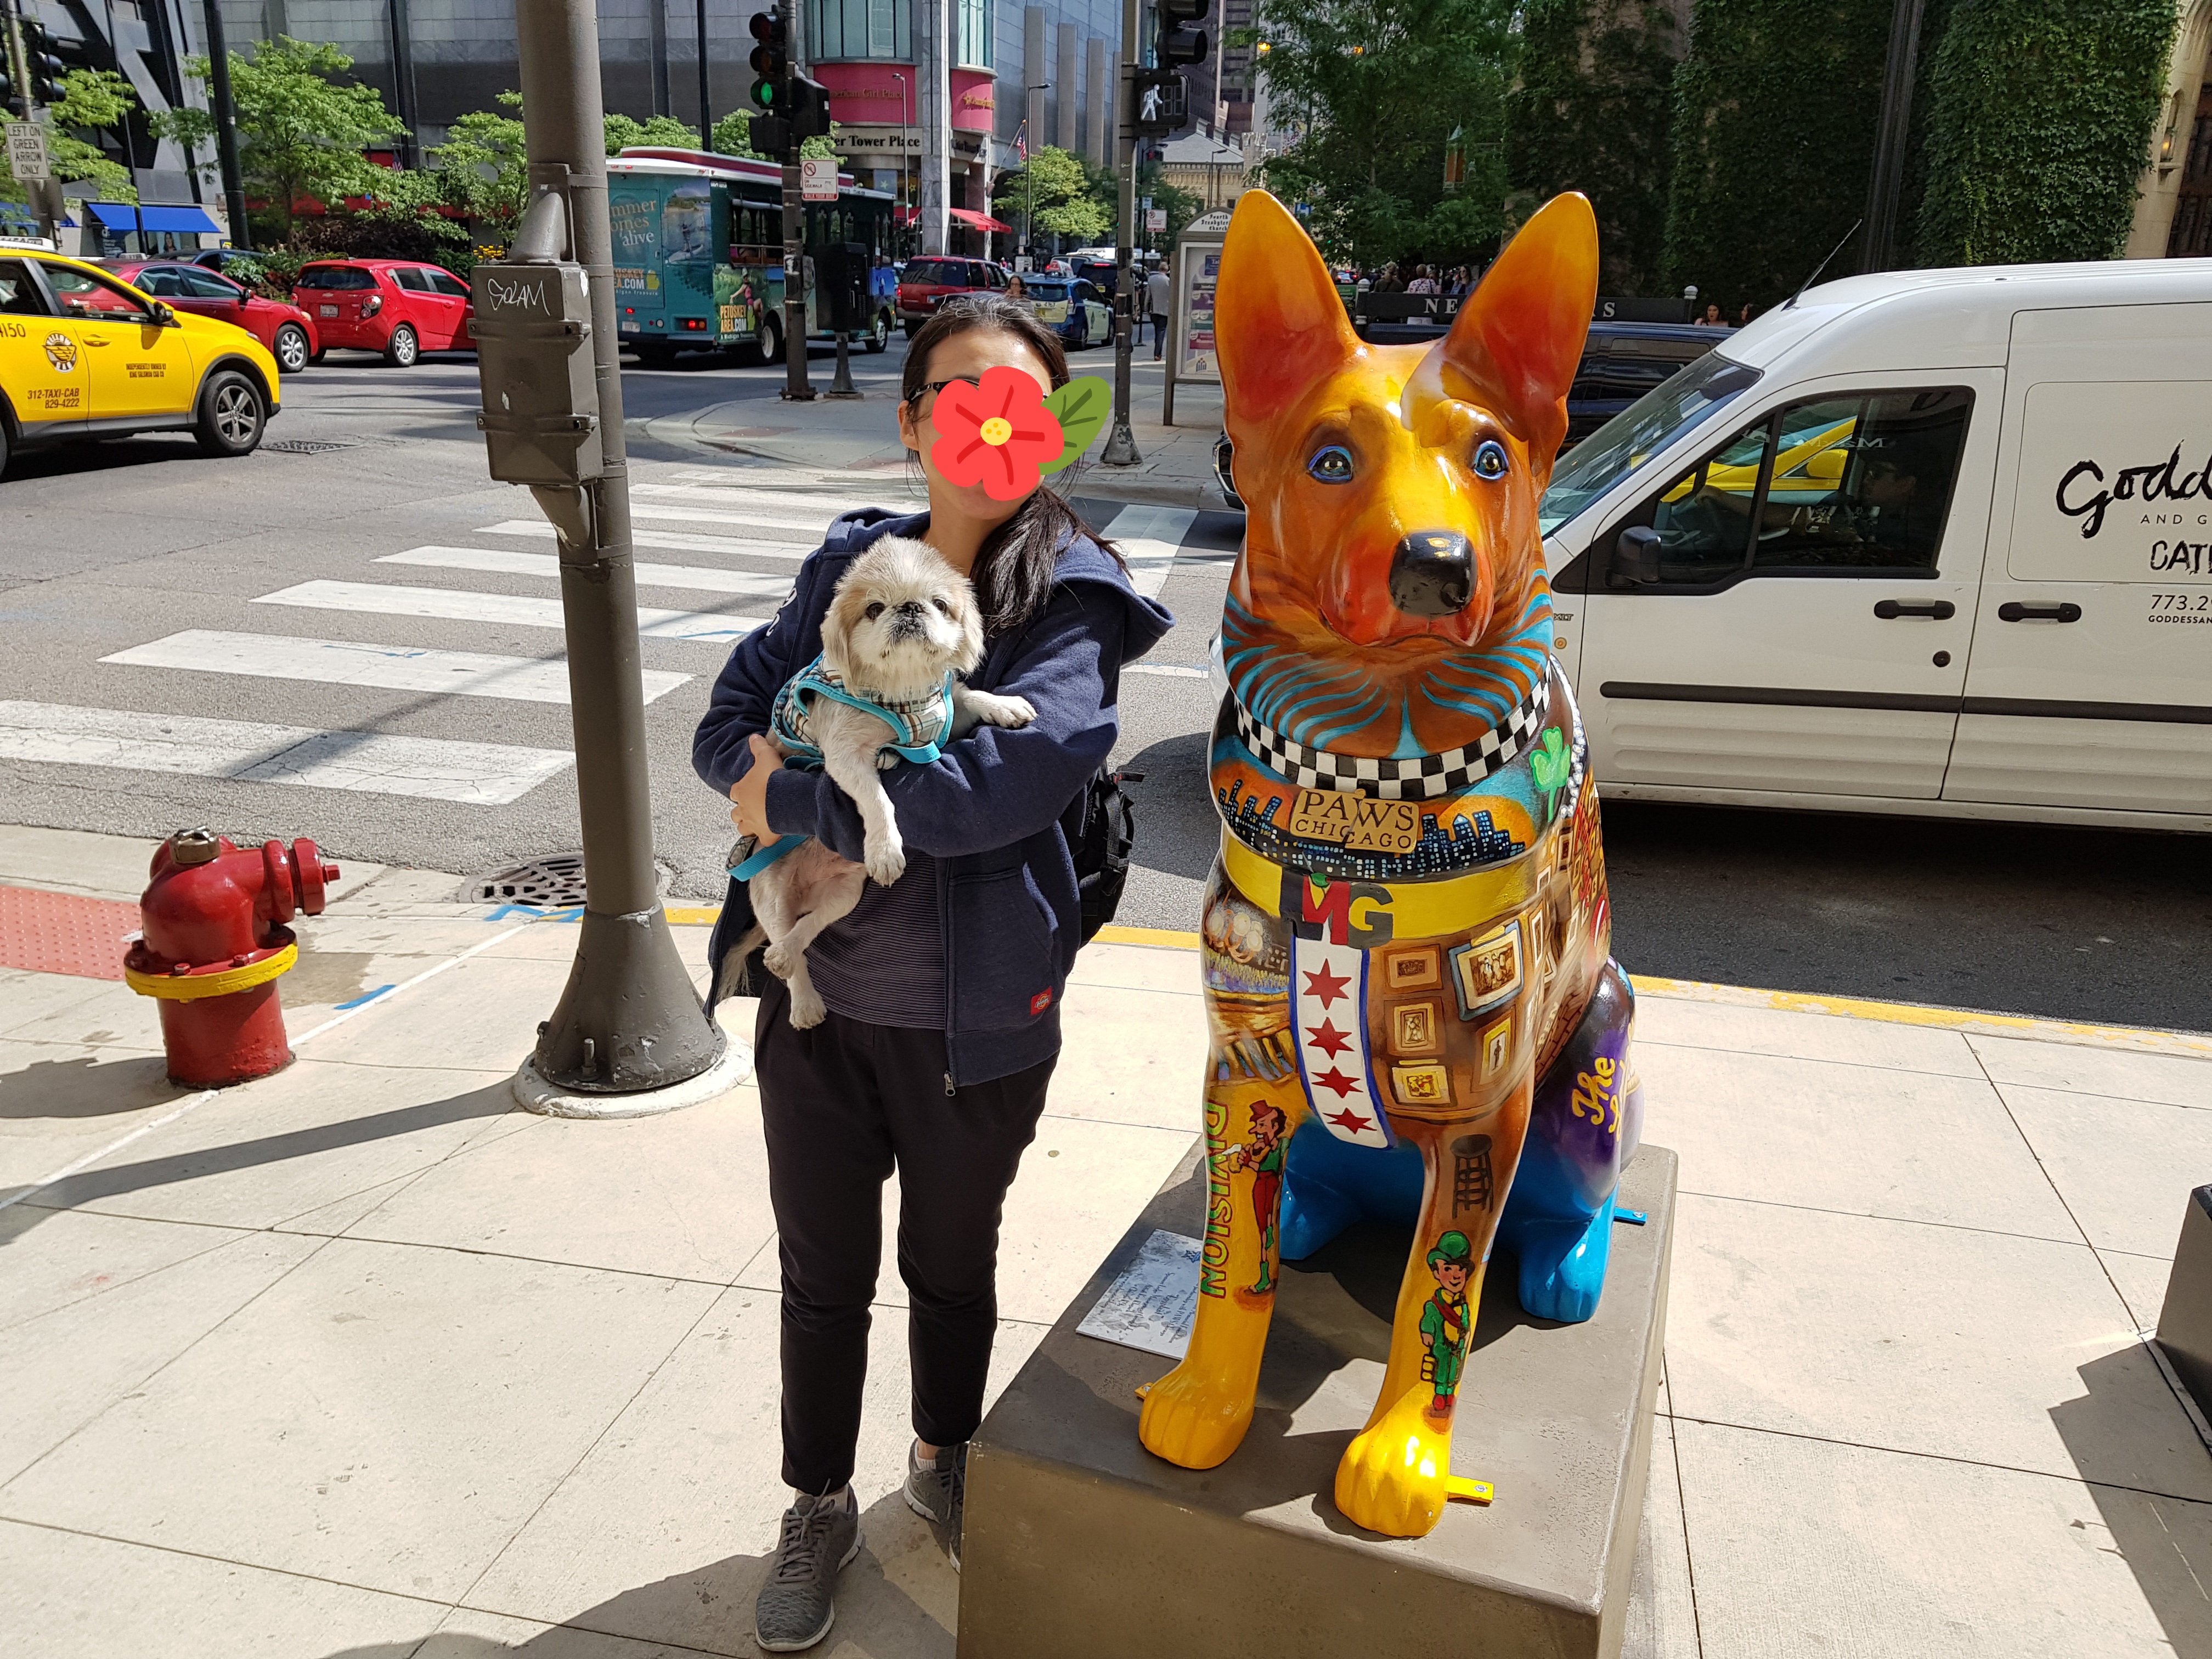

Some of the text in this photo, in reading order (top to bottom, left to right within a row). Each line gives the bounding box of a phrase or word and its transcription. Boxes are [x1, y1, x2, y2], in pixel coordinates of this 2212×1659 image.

[830, 88, 904, 98] merican Girl Place
[8, 126, 41, 136] LEFT ON
[14, 139, 39, 149] GREEN
[849, 136, 885, 147] Tower
[889, 136, 919, 146] Place
[15, 152, 42, 162] ARROW
[21, 165, 39, 174] ONLY
[610, 200, 657, 217] mmer
[610, 217, 650, 232] omes
[622, 230, 655, 246] alive
[614, 268, 644, 278] OSKEY
[720, 304, 747, 319] PETOSKEY
[1423, 298, 1459, 314] NE
[720, 318, 747, 333] AREA.COM
[27, 387, 80, 399] 312-TAXI-CAB
[44, 398, 80, 409] 829-4222
[2140, 514, 2183, 524] AND
[2150, 540, 2212, 575] CAT
[2151, 594, 2212, 611] 773.2
[1553, 613, 1574, 622] XLT
[1300, 791, 1414, 831] PAWS
[1295, 819, 1412, 849] CHICAGO
[1571, 1057, 1616, 1126] The
[1200, 1099, 1233, 1299] DIVISION
